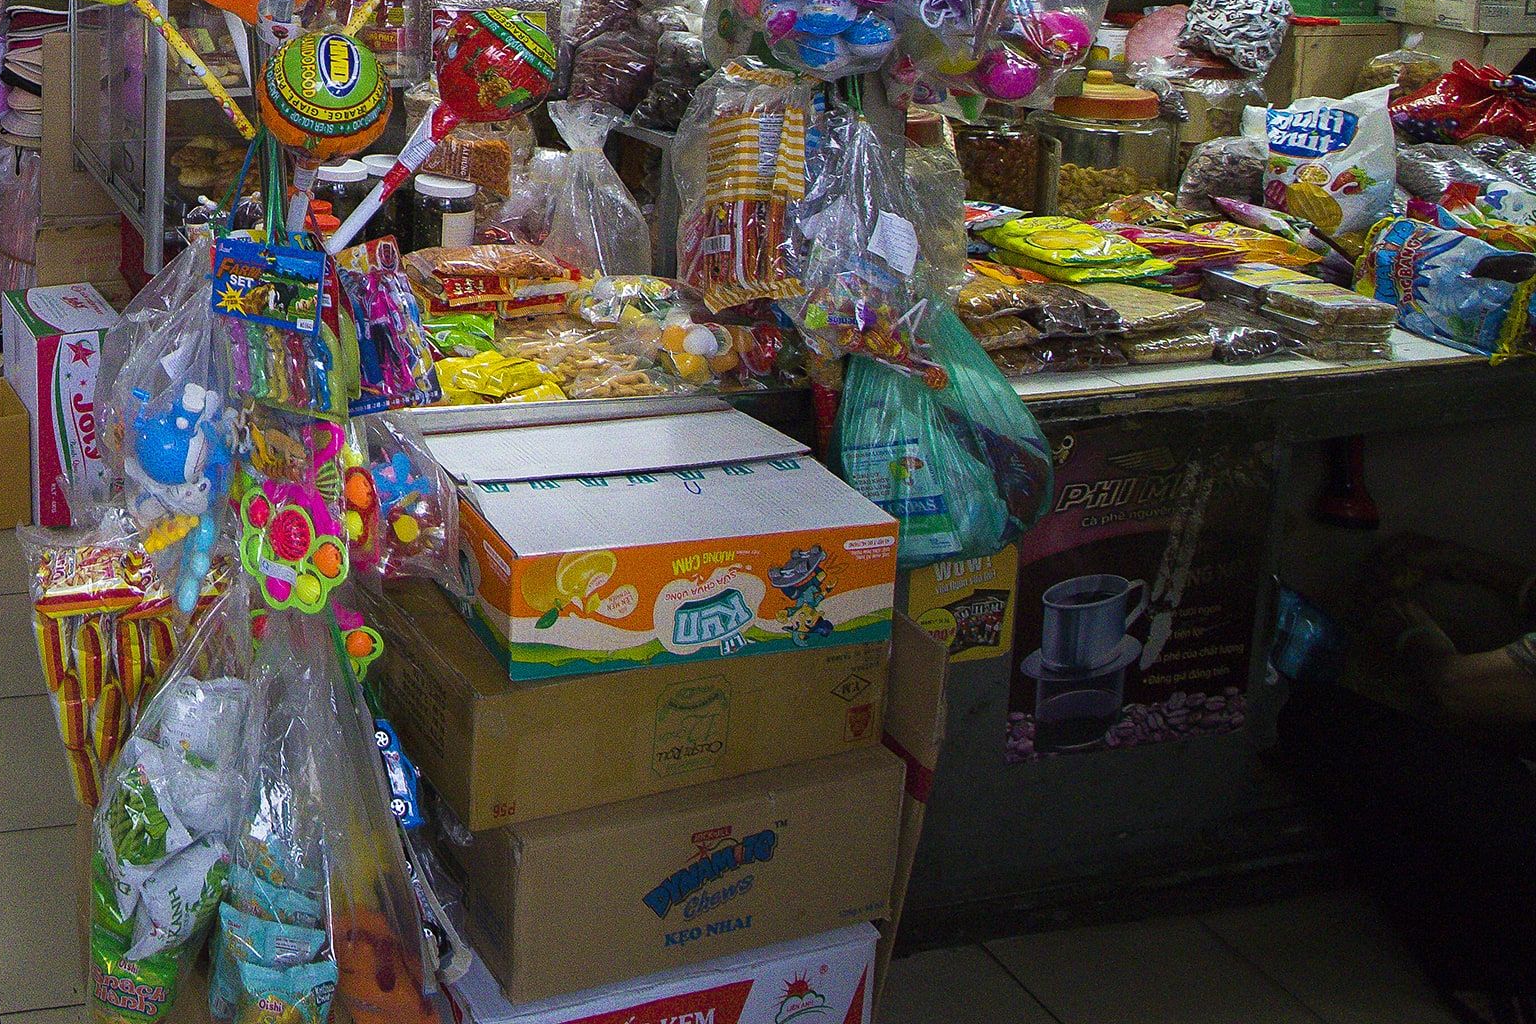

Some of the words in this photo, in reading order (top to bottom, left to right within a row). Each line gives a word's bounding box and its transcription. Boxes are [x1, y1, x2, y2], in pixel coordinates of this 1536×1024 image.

[328, 39, 350, 83] HMD
[216, 257, 262, 279] FARM
[229, 274, 254, 288] SET
[1055, 478, 1138, 513] PHI
[683, 875, 754, 921] Chews
[664, 926, 702, 947] KẸO
[705, 916, 754, 936] NHAI
[258, 999, 284, 1014] Oishi
